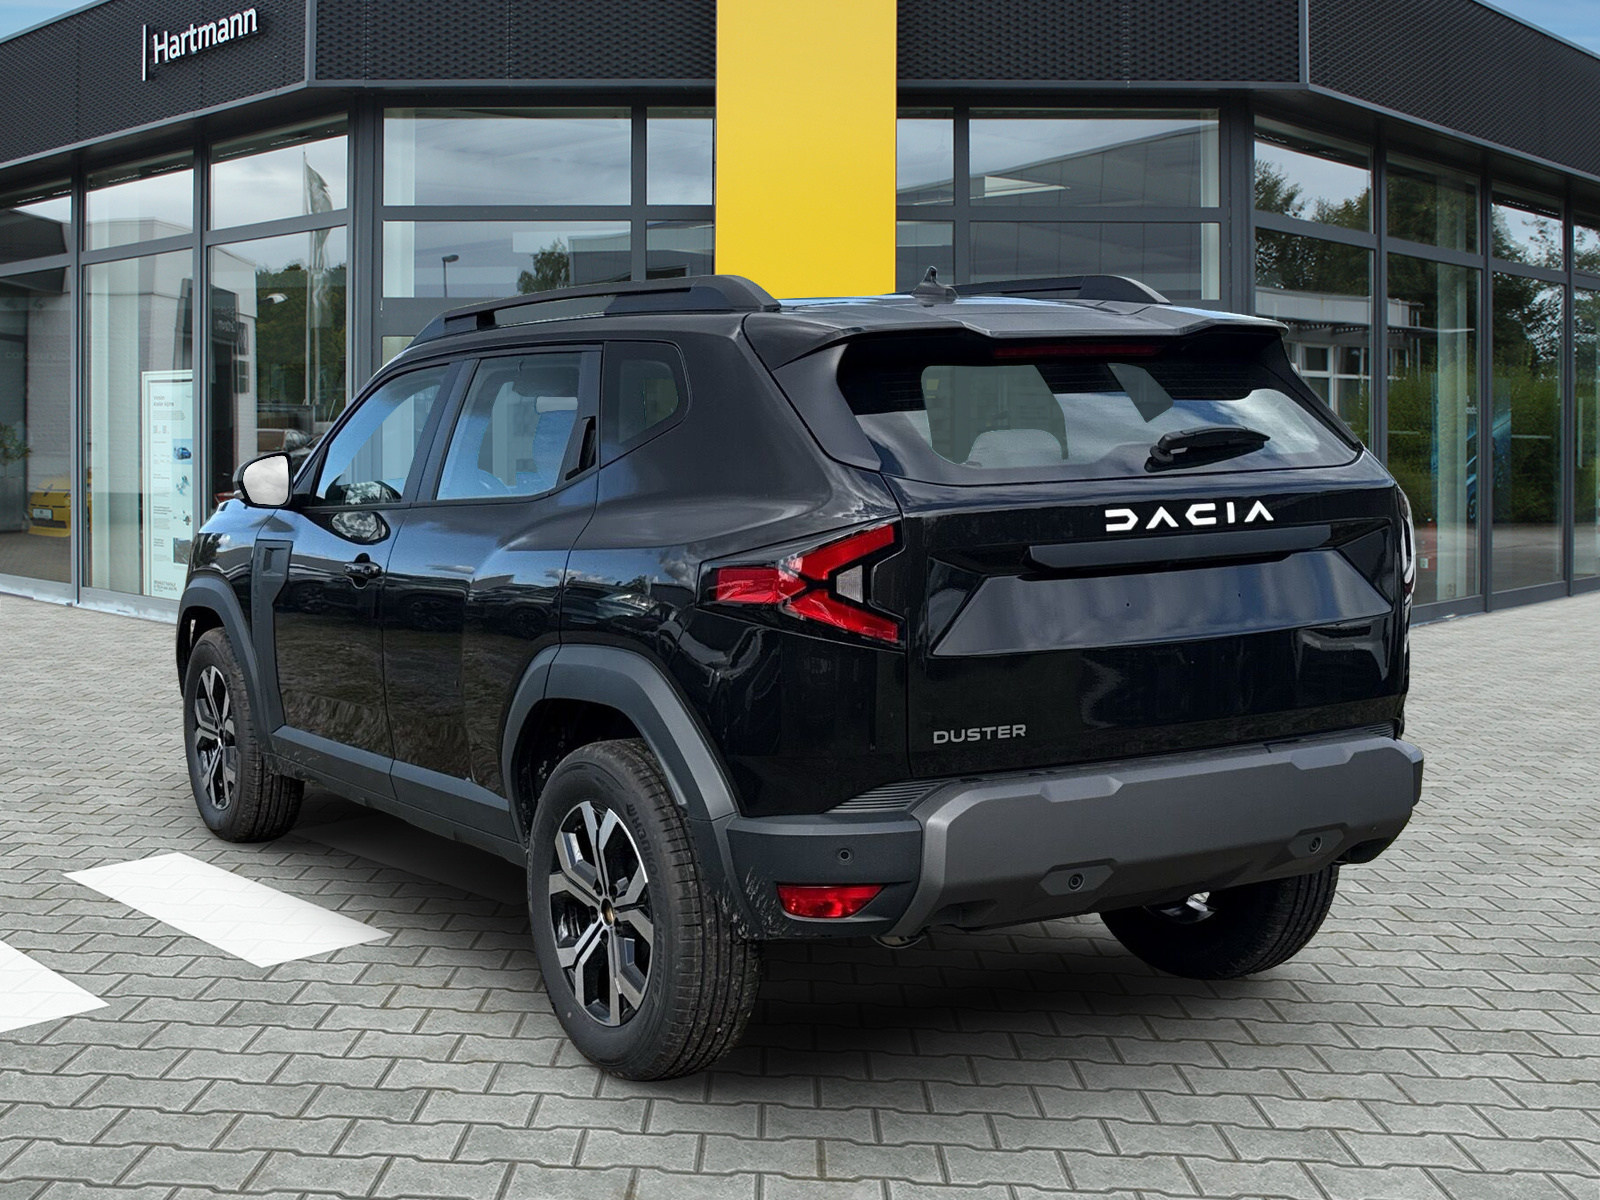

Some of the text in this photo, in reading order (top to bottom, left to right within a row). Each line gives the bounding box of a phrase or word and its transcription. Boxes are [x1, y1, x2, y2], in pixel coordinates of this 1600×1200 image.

[153, 8, 258, 64] Hartmann
[1105, 500, 1274, 532] DACIA
[933, 724, 1027, 744] DUSTER
